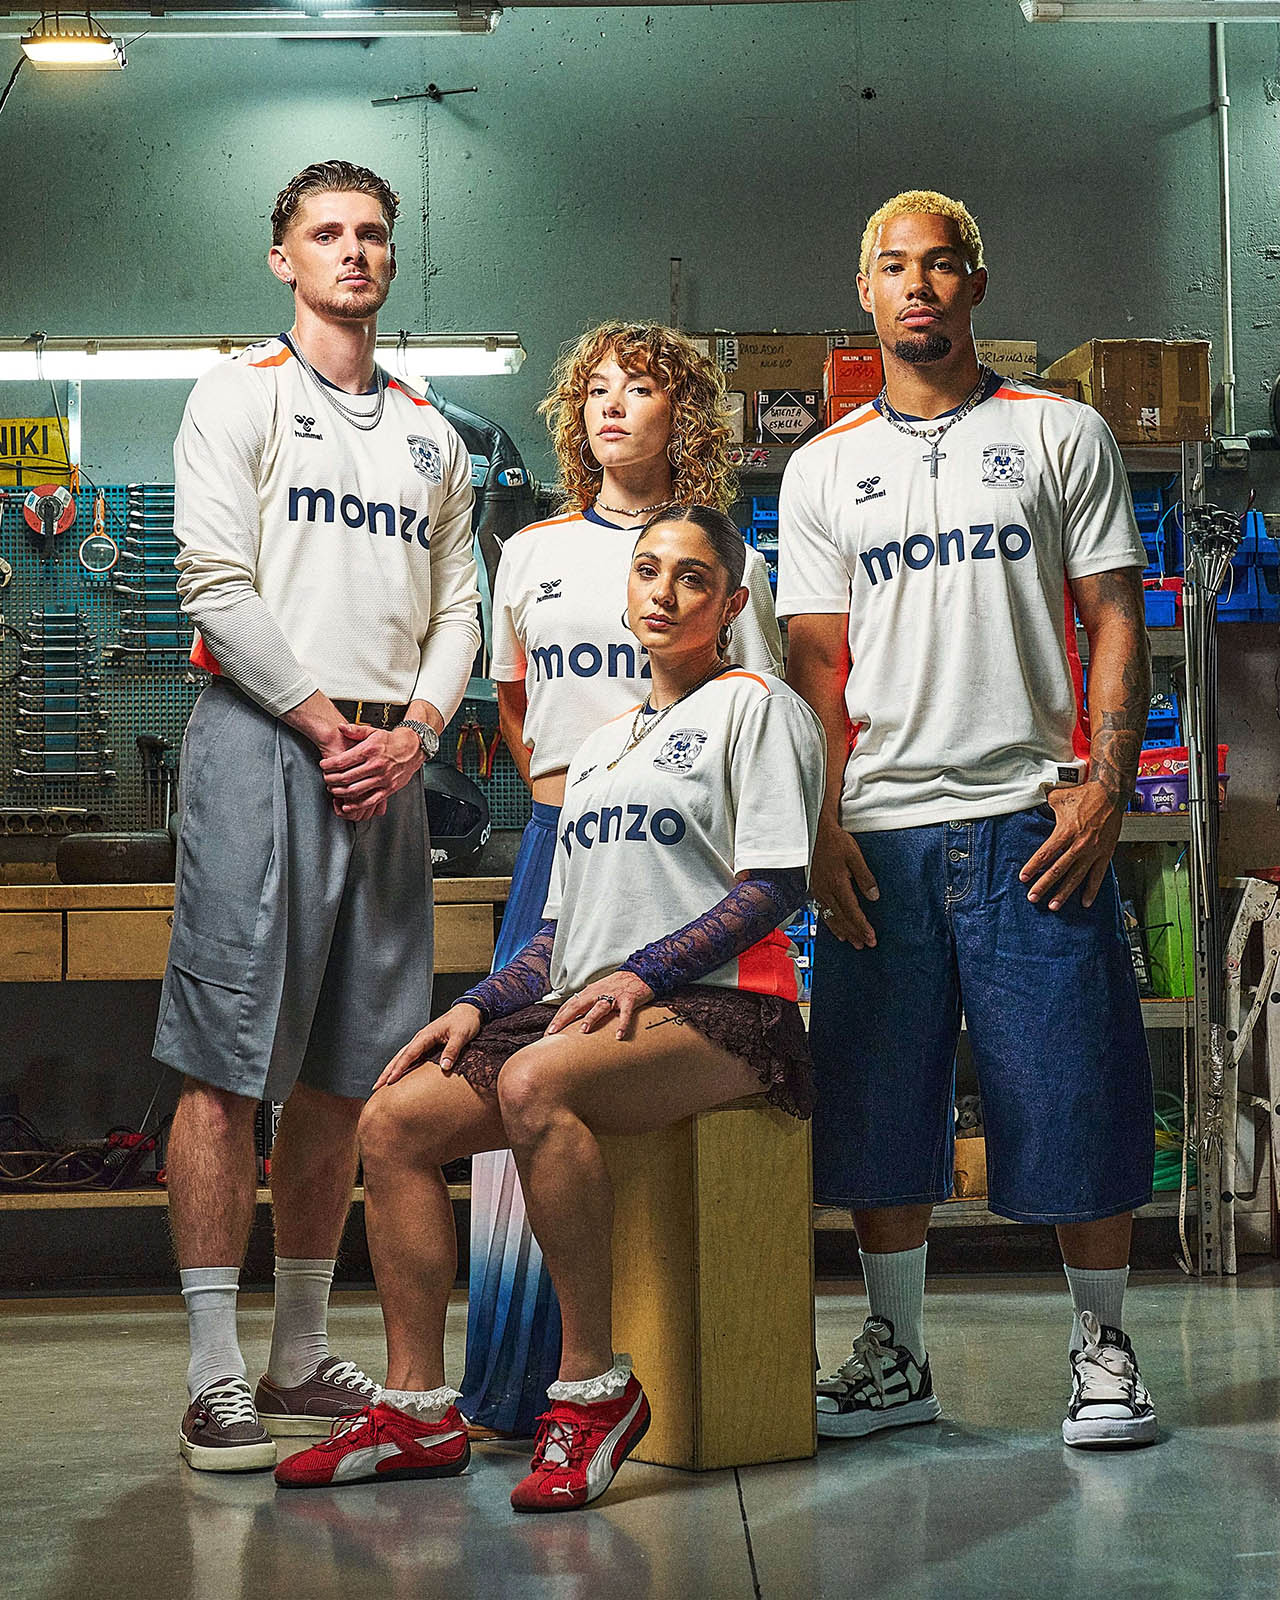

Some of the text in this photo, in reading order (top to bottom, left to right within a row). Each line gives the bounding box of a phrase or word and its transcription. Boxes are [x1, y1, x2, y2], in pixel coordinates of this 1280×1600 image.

[294, 430, 323, 440] hummel
[855, 489, 886, 505] hummel
[859, 523, 1032, 586] monzo
[1152, 794, 1175, 803] HEROES
